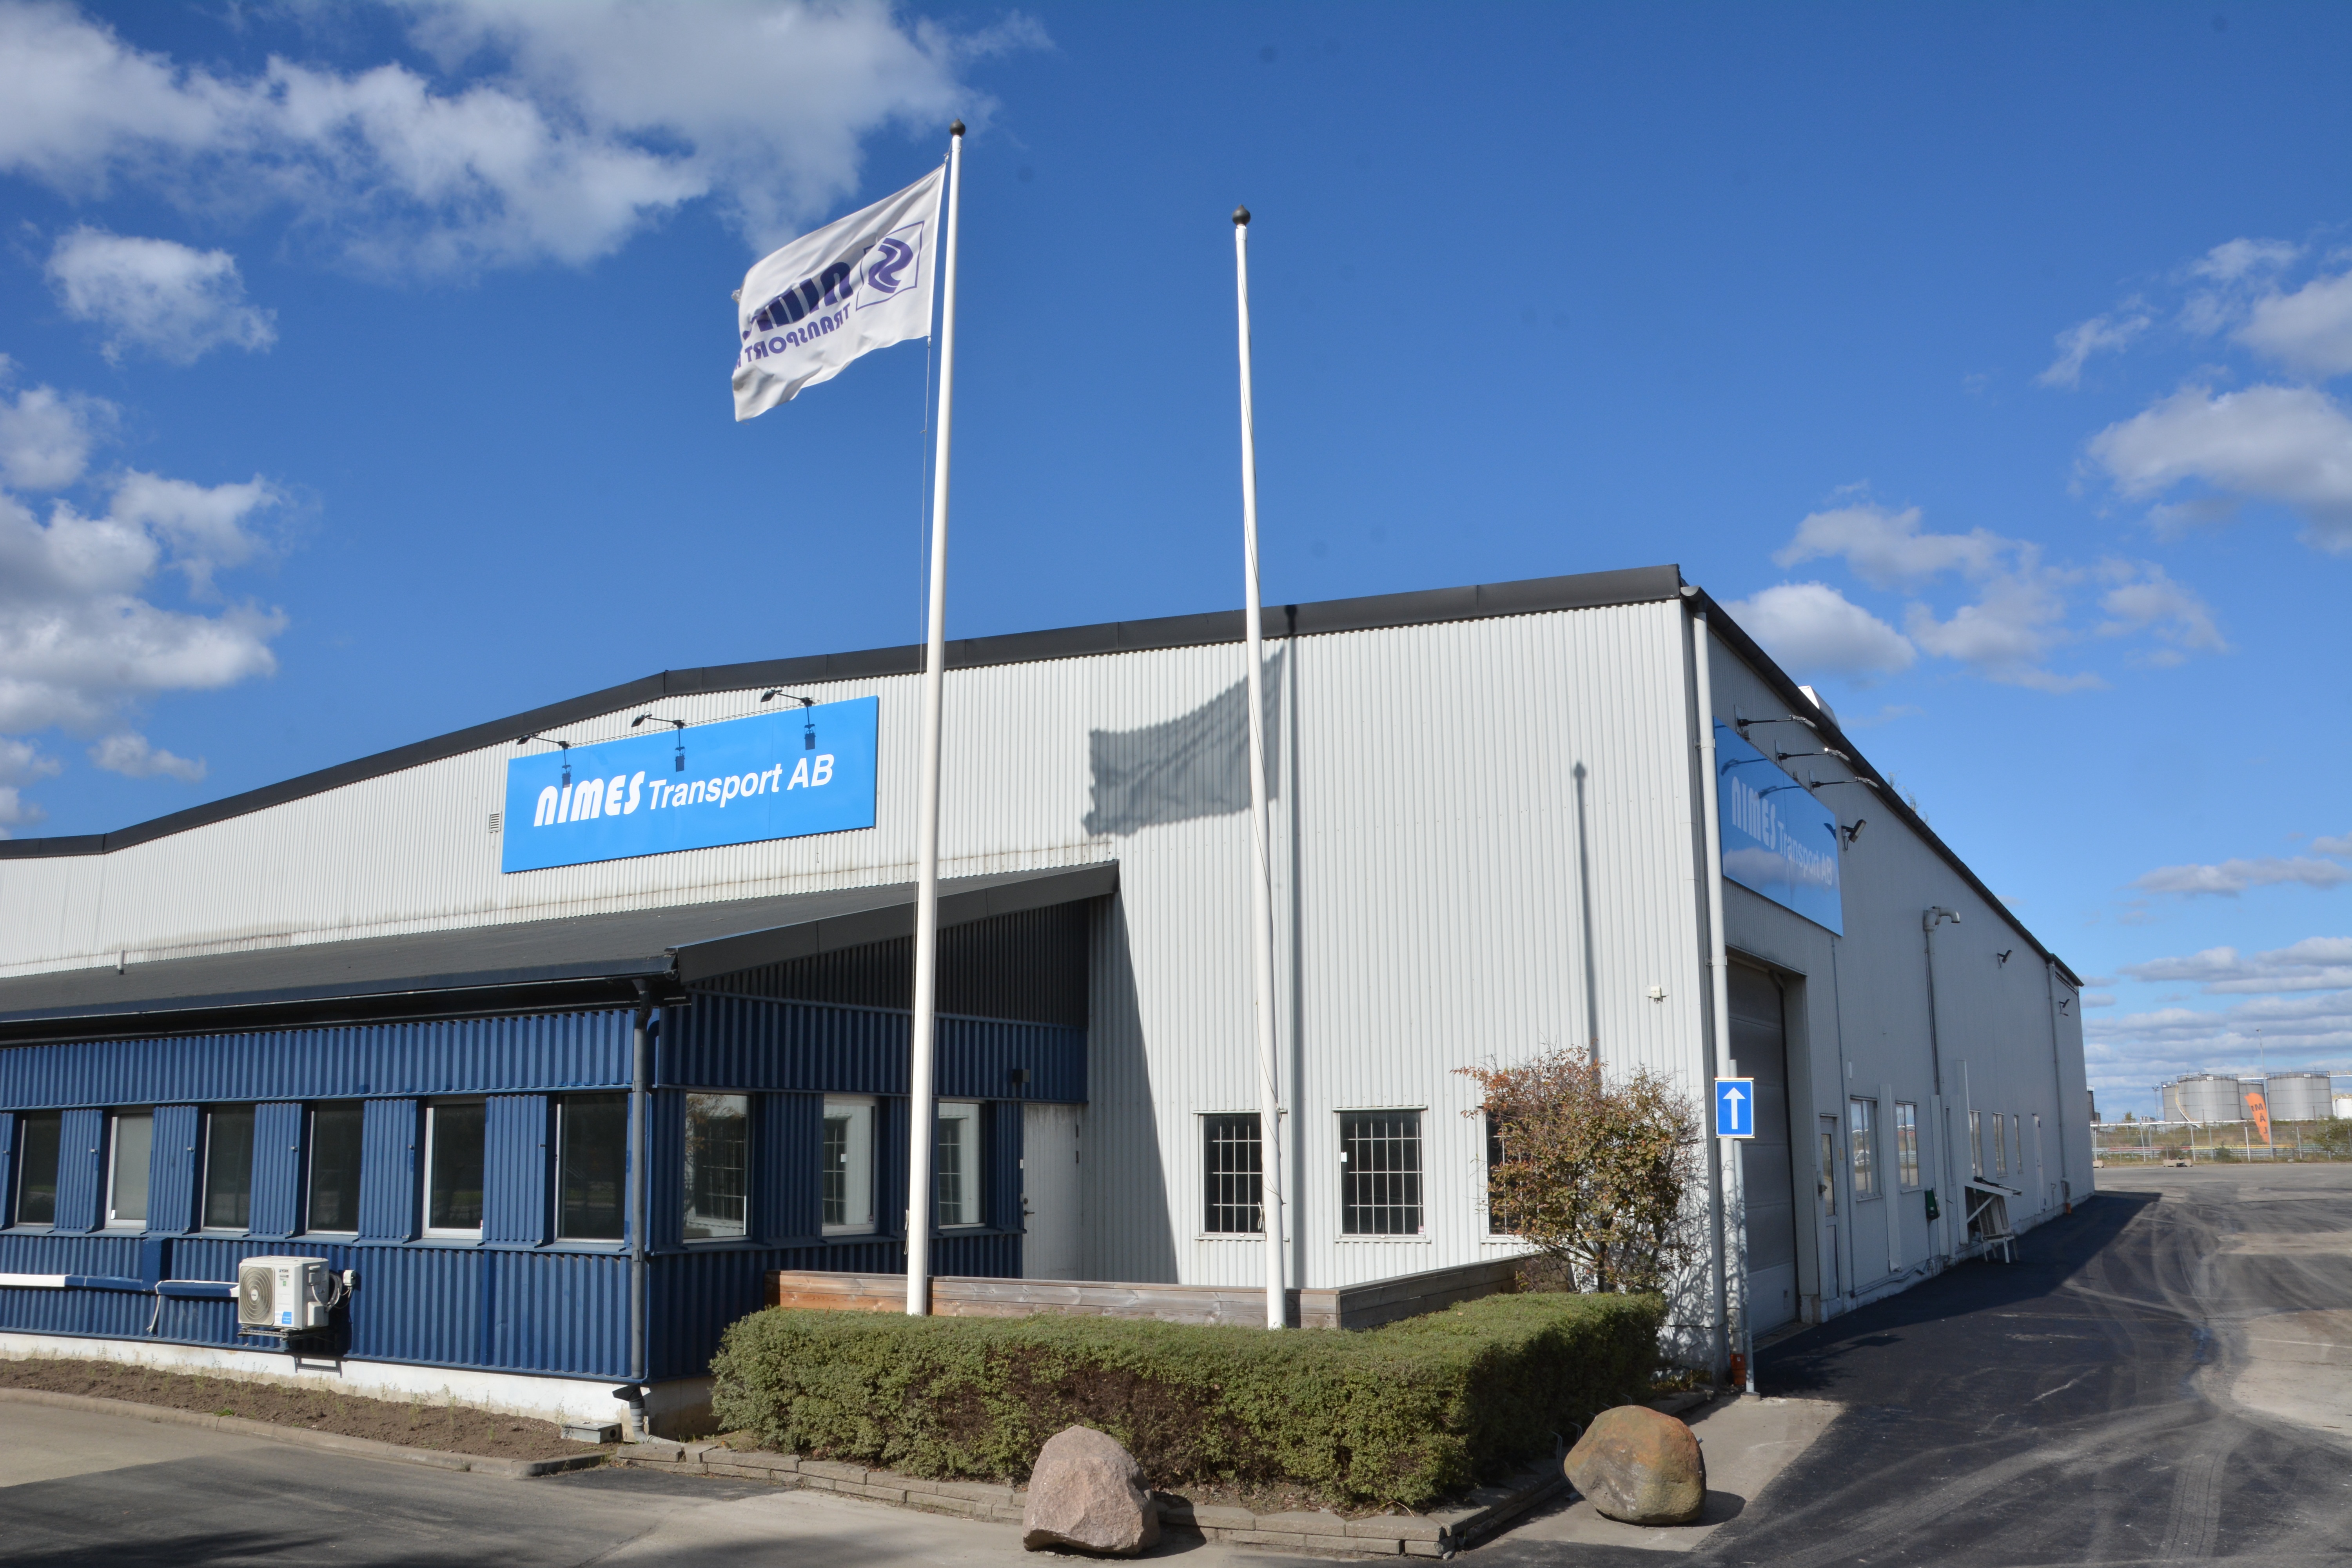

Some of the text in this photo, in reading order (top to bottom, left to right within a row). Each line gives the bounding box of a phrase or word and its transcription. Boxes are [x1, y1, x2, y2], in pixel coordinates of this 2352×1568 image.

[533, 753, 835, 827] NIMES Transport AB
[1732, 776, 1833, 886] NIMES Transport AB
